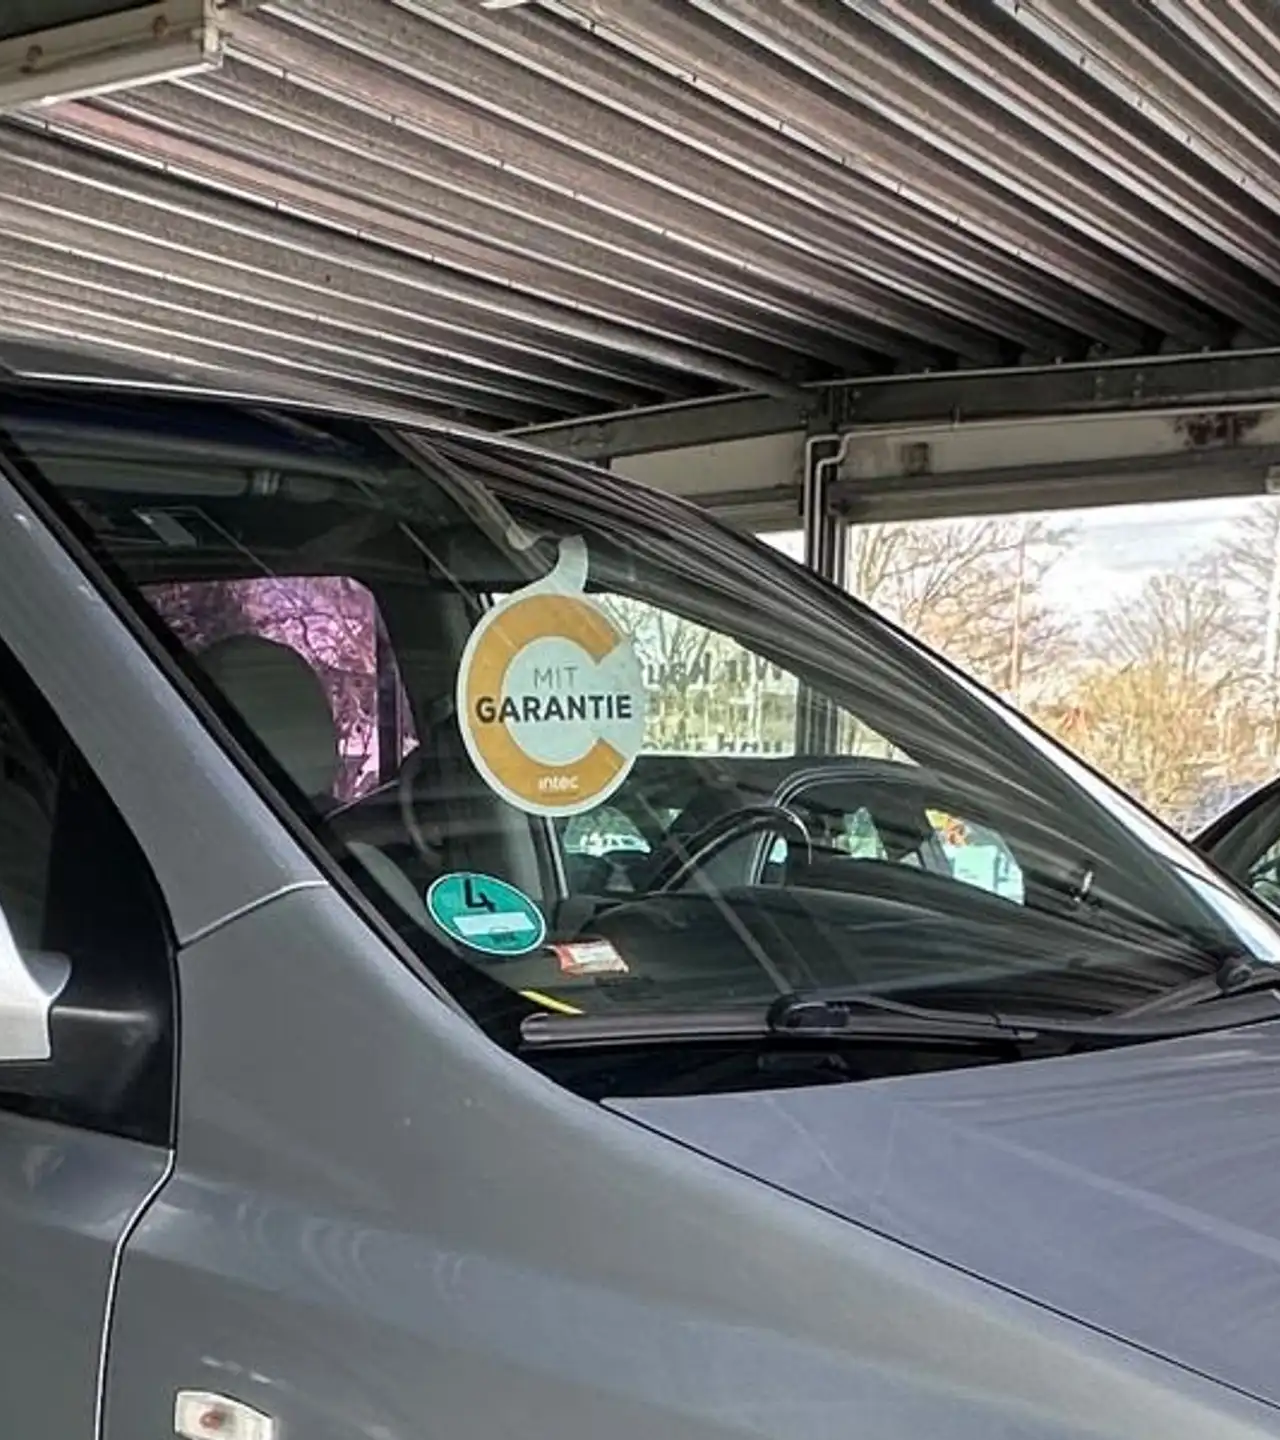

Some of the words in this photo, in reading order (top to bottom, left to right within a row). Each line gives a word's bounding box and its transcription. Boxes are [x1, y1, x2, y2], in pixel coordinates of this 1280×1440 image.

[533, 665, 579, 690] MIT
[475, 694, 632, 723] GARANTIE
[464, 878, 497, 913] 4
